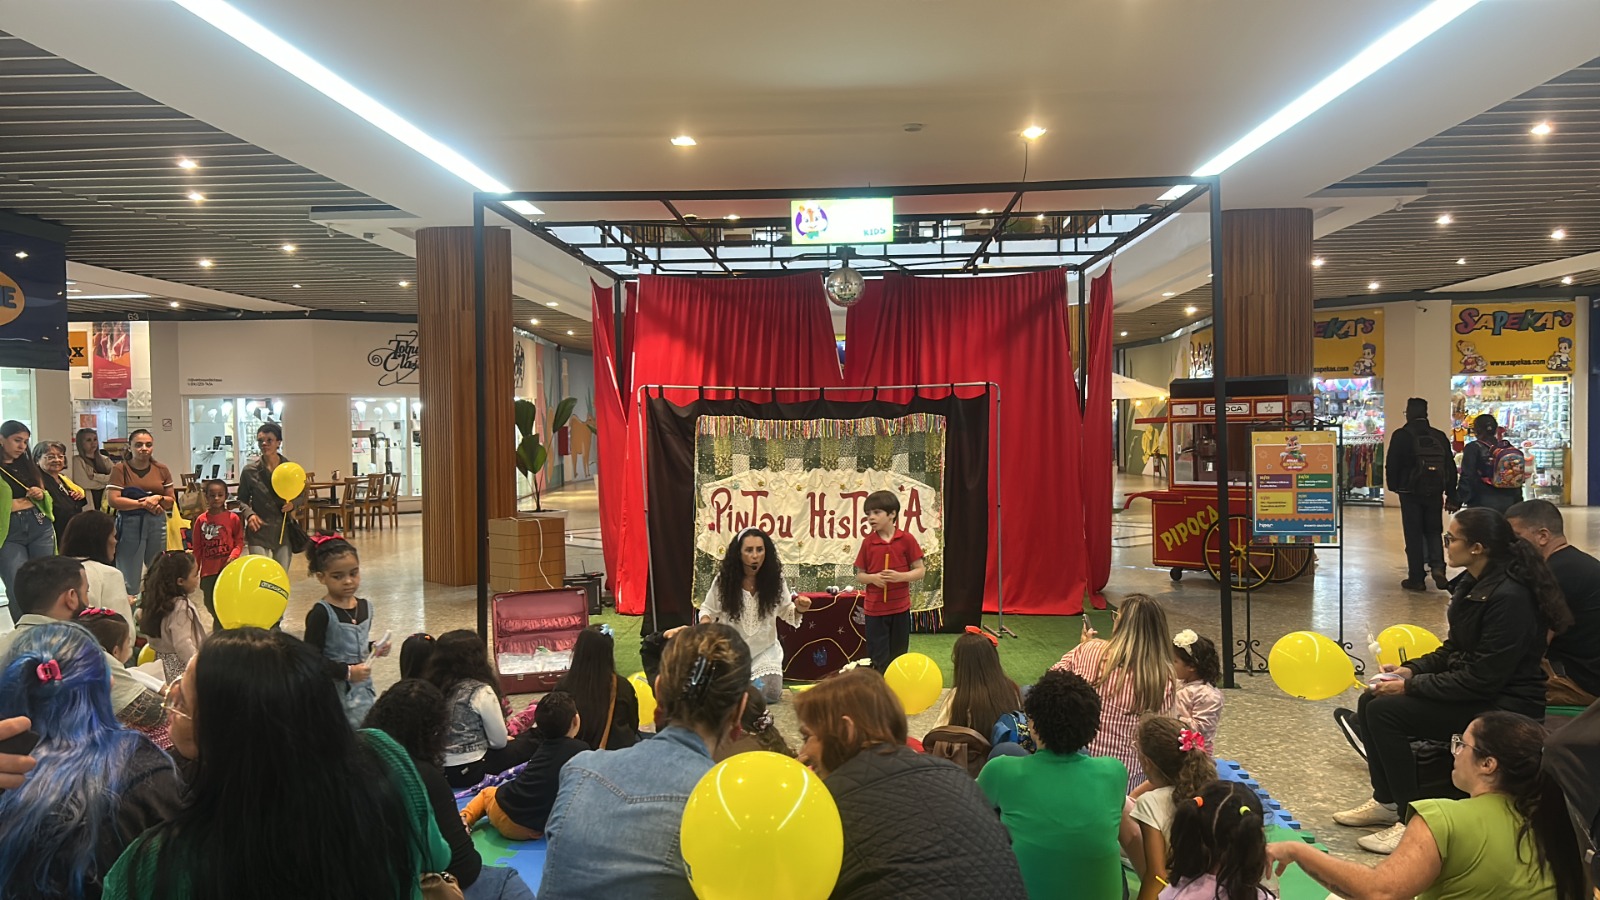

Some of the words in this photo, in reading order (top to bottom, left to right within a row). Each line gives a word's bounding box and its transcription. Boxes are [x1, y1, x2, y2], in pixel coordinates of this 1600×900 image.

[863, 228, 886, 236] KIDS
[0, 285, 17, 308] E
[383, 350, 419, 371] Clas
[387, 339, 419, 361] Toqu
[1160, 504, 1219, 551] PIPOCA
